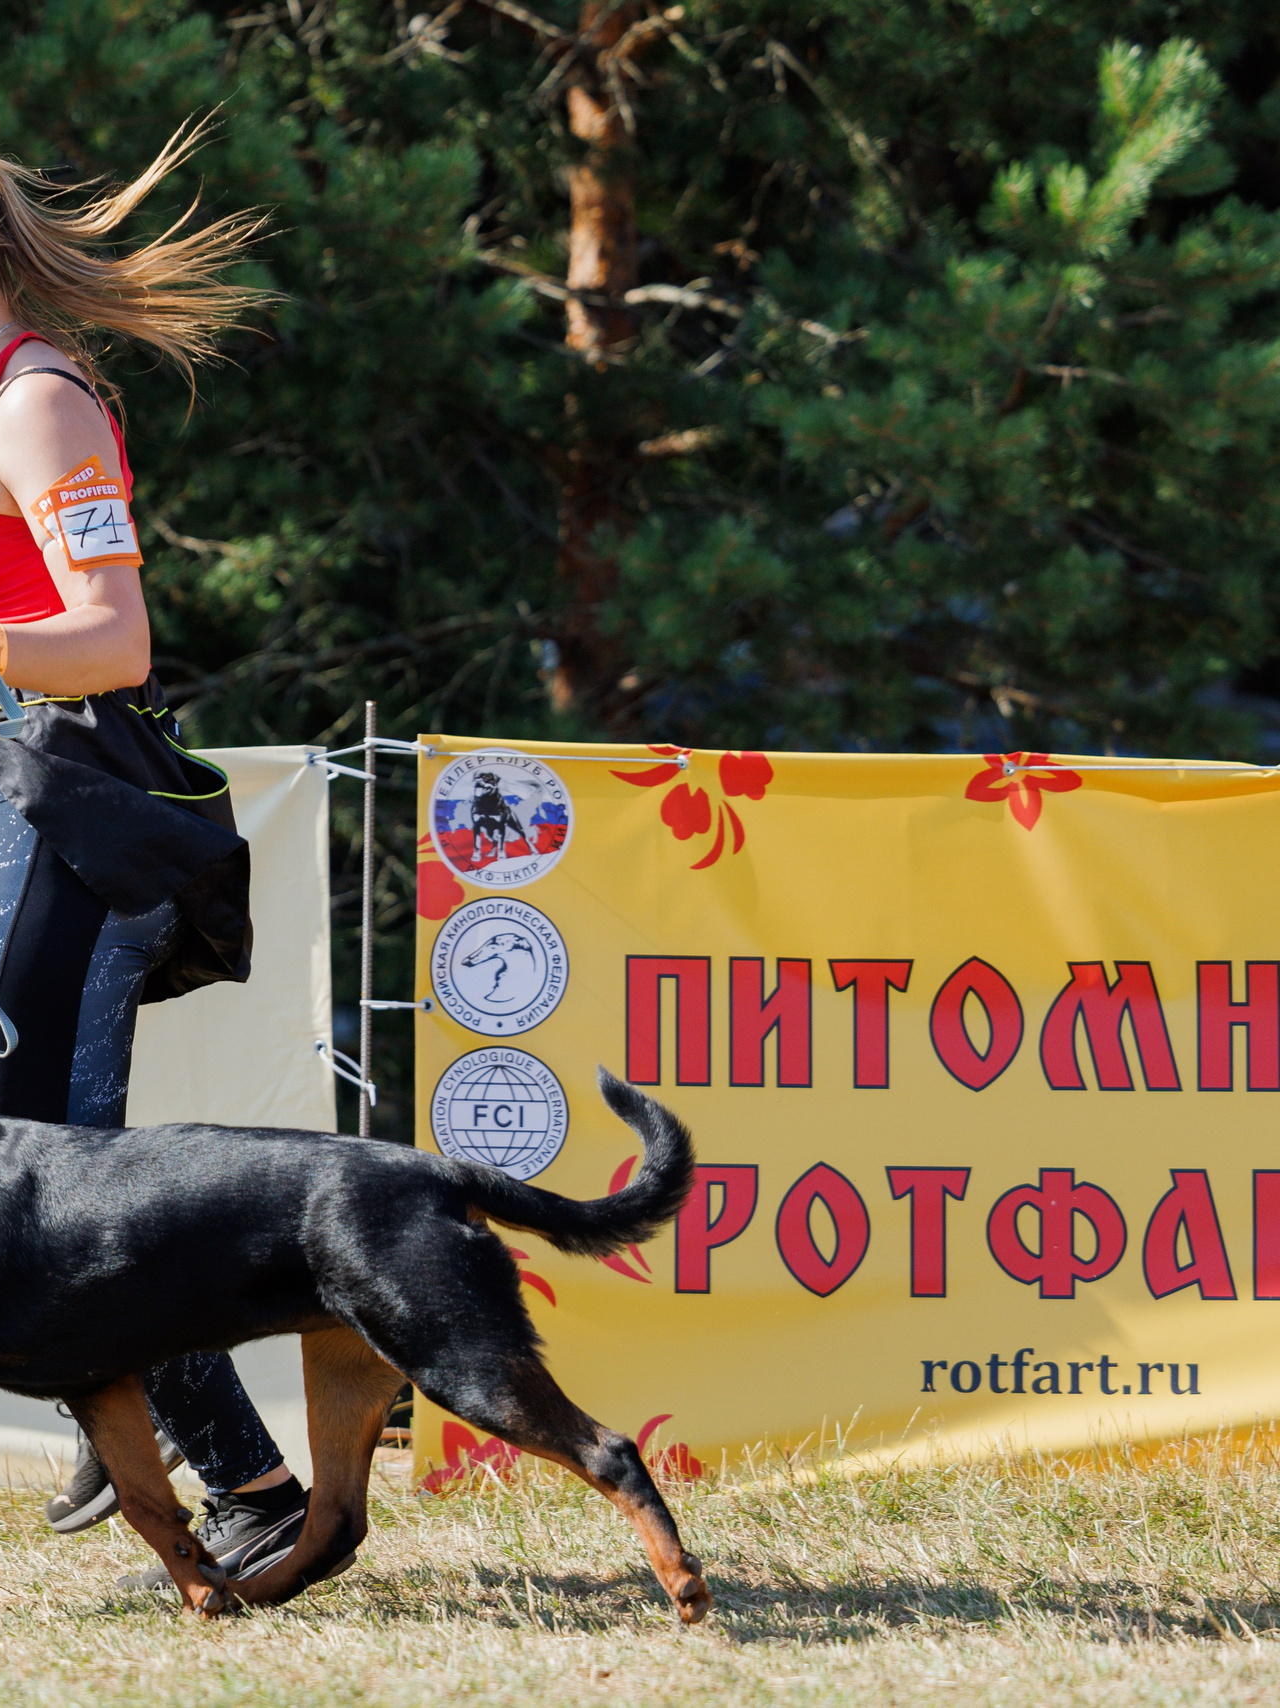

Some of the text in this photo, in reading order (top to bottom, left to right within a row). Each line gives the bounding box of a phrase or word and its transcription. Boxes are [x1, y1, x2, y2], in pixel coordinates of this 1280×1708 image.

[64, 503, 124, 548] 71
[436, 904, 563, 1027] РОССИЙСКАЯ КИНОЛОГИЧЕСКАЯ ФЕДЕРАЦИЯ
[625, 955, 1280, 1093] ПИТОМН
[442, 1051, 535, 1091] CYNOLOGIQUE
[520, 1069, 564, 1175] INTERNATIONALE
[473, 1104, 524, 1128] FCI
[921, 1347, 1201, 1396] rotfart.ru
